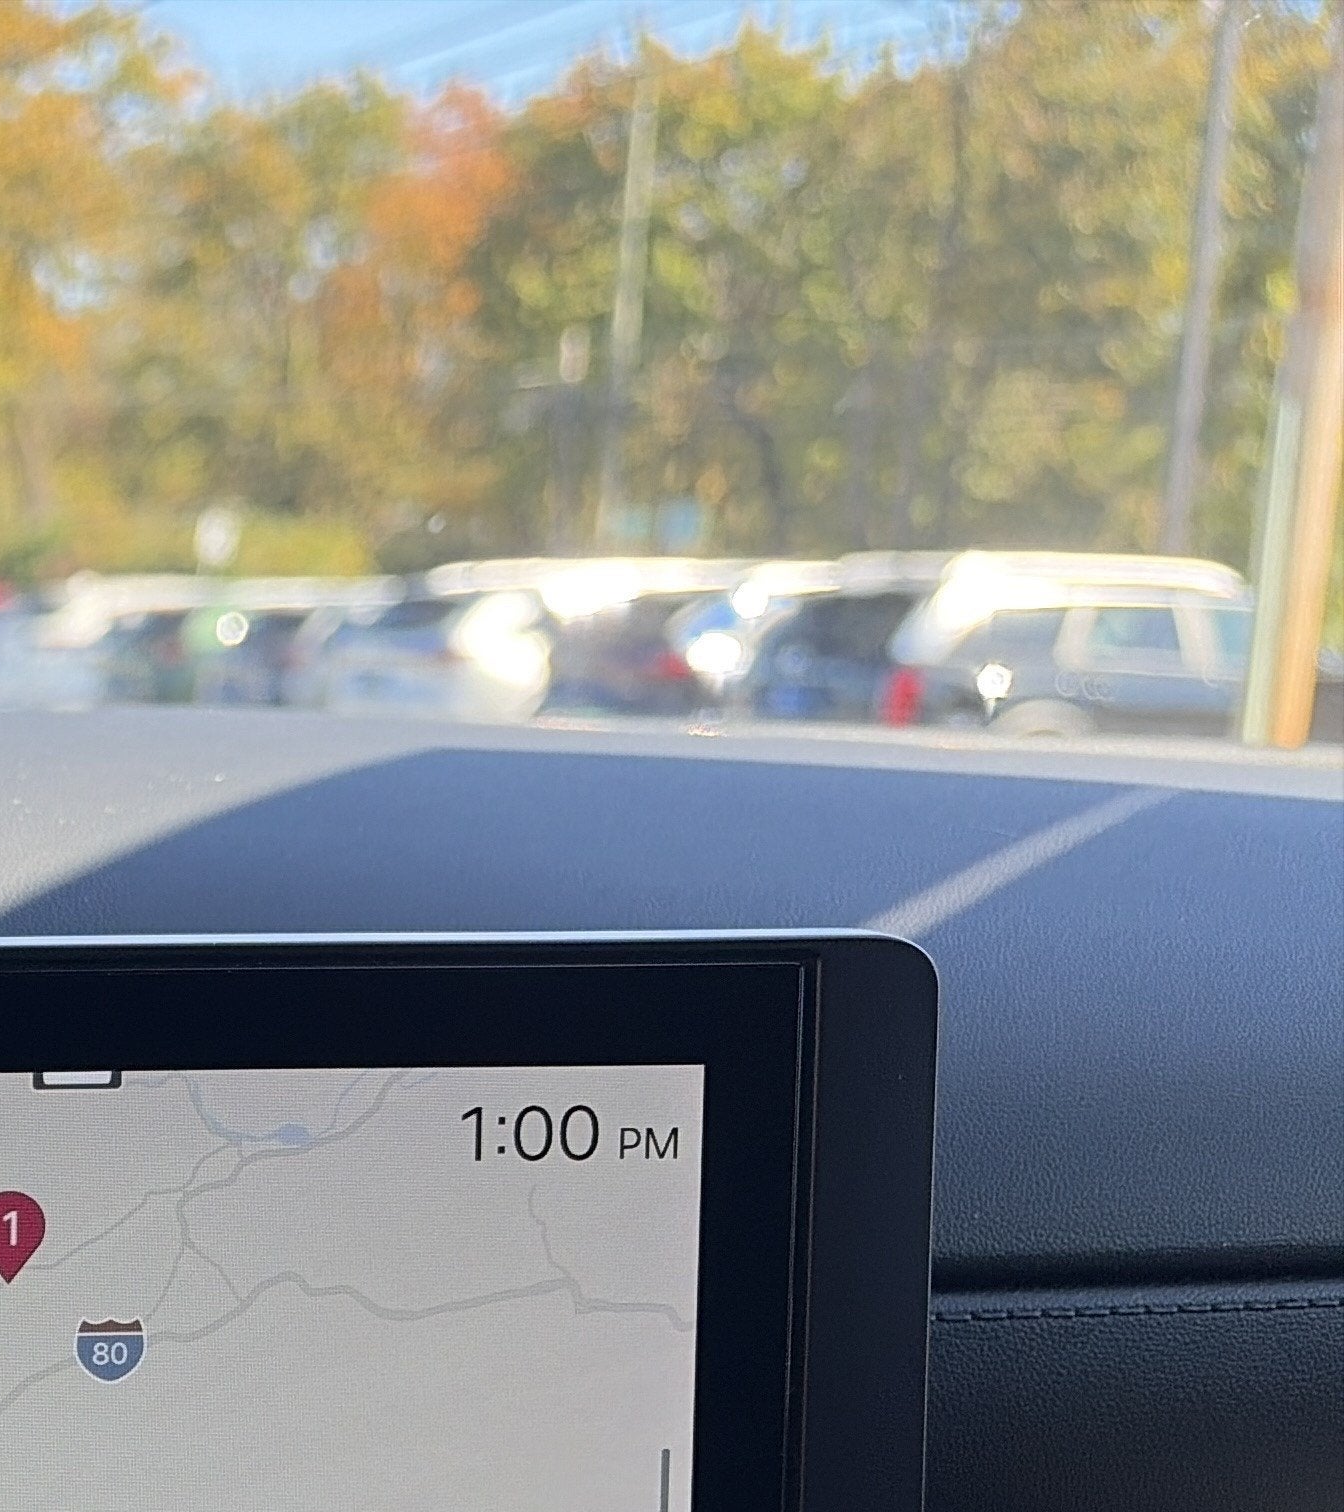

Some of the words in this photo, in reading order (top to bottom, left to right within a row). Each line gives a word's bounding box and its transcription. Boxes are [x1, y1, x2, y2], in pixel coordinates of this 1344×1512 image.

[461, 1104, 600, 1162] 1:00
[619, 1128, 679, 1160] PM
[2, 1210, 19, 1246] 1
[92, 1343, 128, 1365] 80
